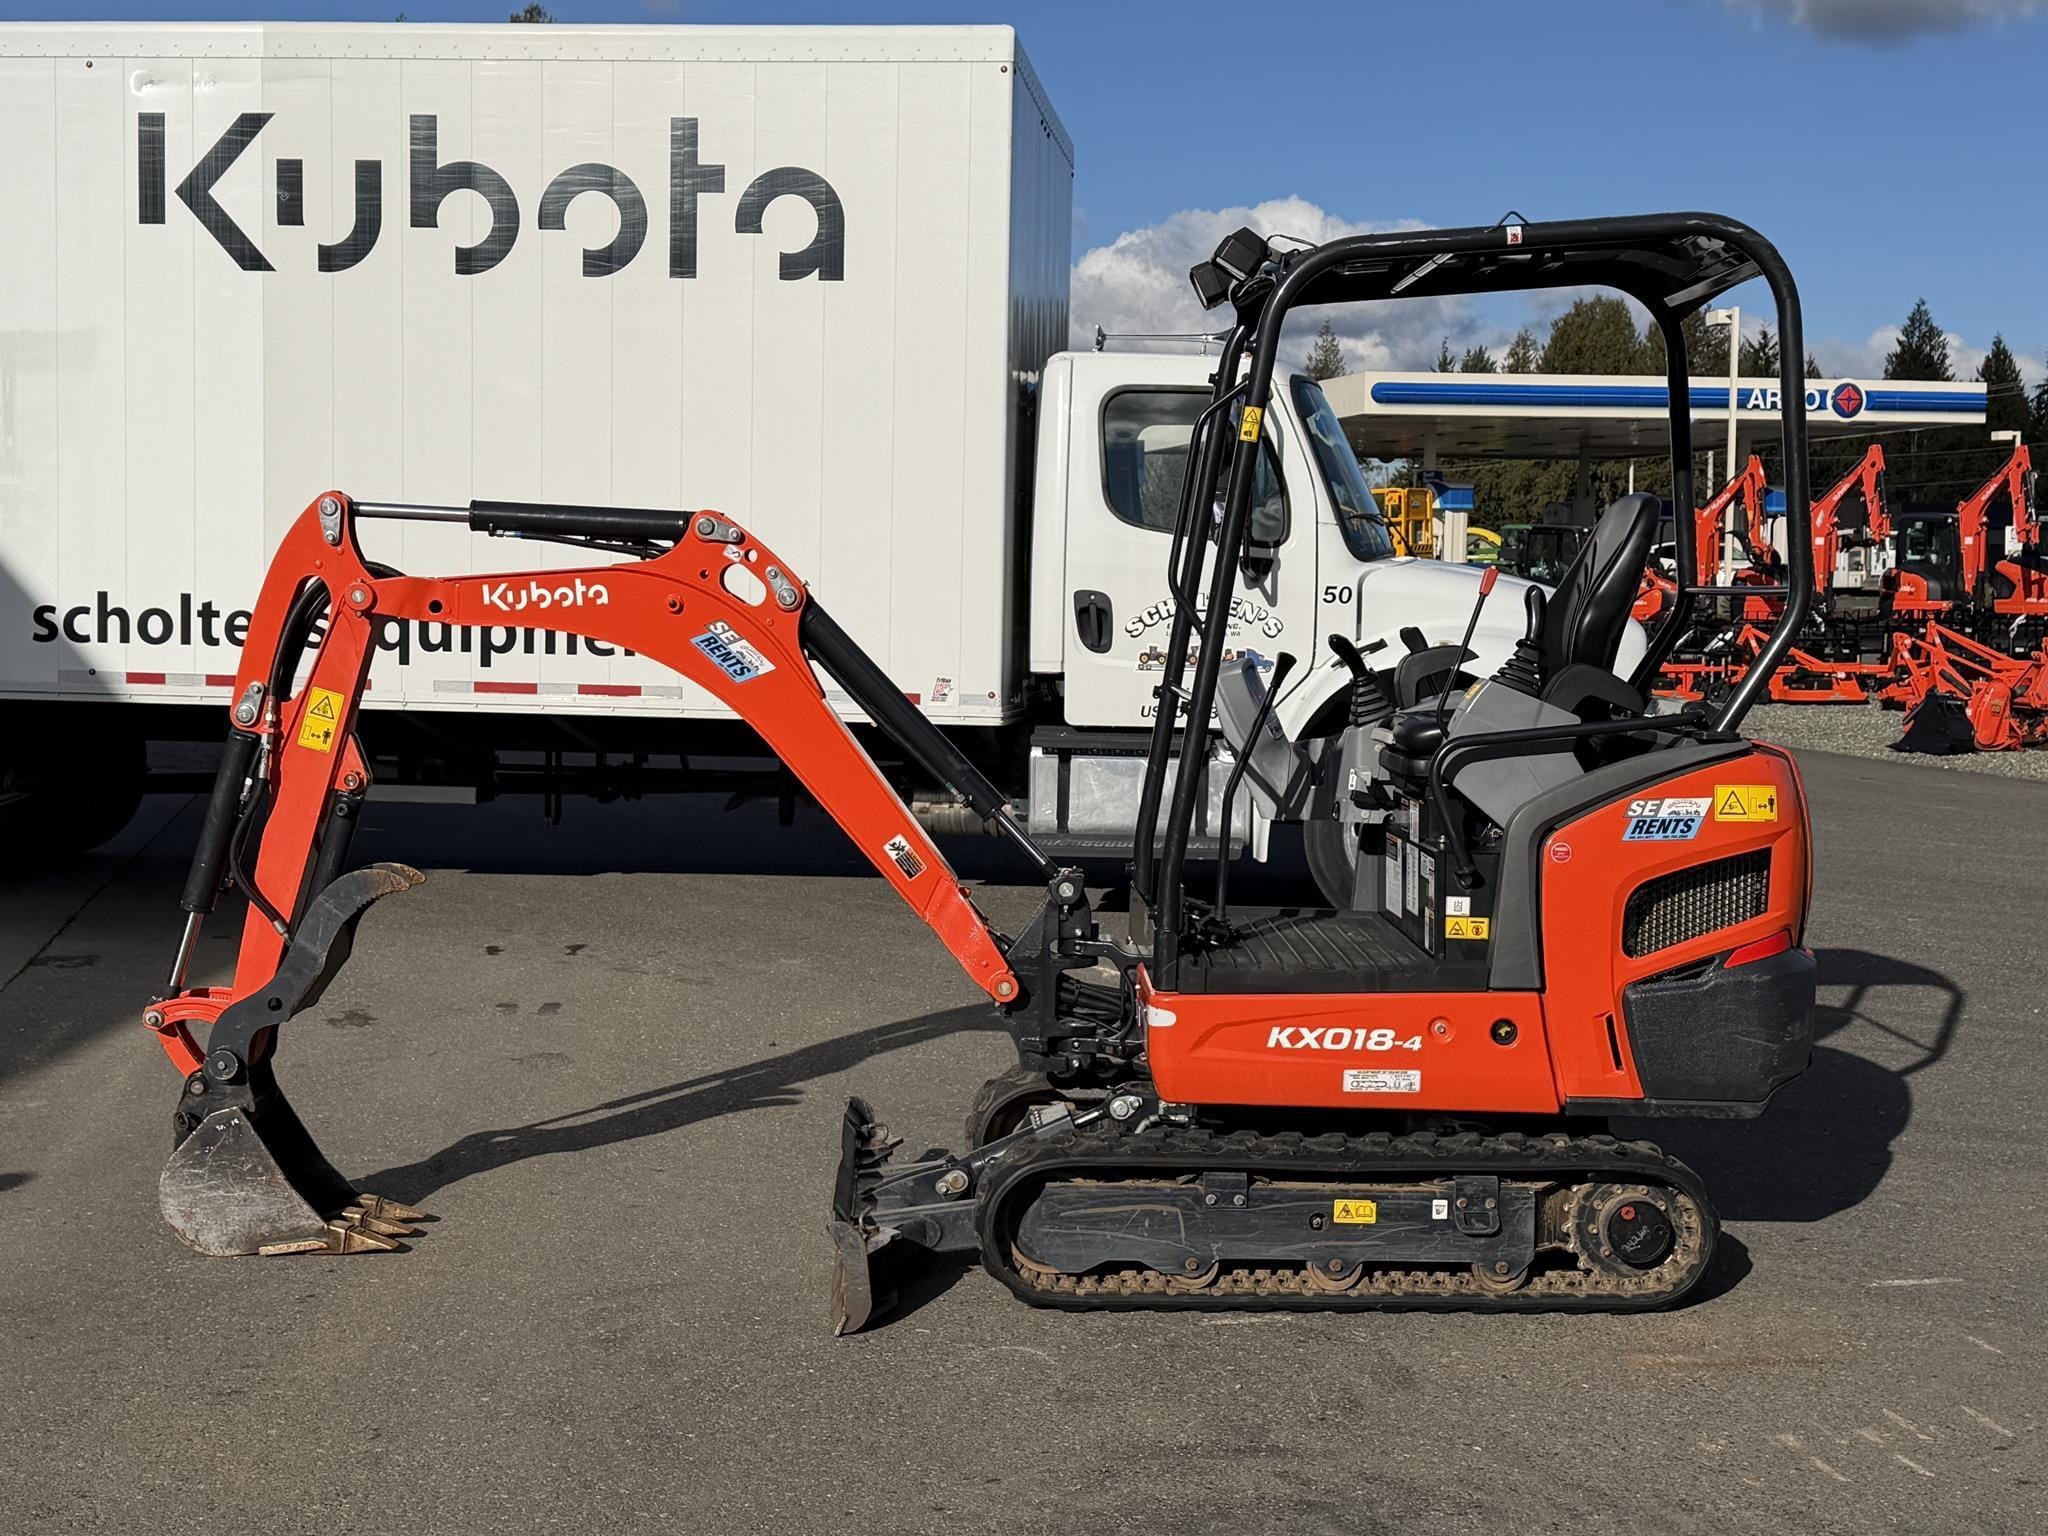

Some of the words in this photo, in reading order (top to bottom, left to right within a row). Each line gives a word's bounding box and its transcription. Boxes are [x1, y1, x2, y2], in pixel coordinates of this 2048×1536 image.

[138, 112, 845, 281] Kubota
[1746, 388, 1821, 411] ARO
[483, 578, 608, 611] Kubota
[1322, 585, 1353, 604] 50
[32, 591, 330, 649] scholtes
[708, 621, 741, 646] SE
[699, 635, 752, 678] RENTS
[1627, 799, 1661, 817] SE
[1630, 818, 1696, 835] RENTS
[1267, 1026, 1423, 1051] KX018-4
